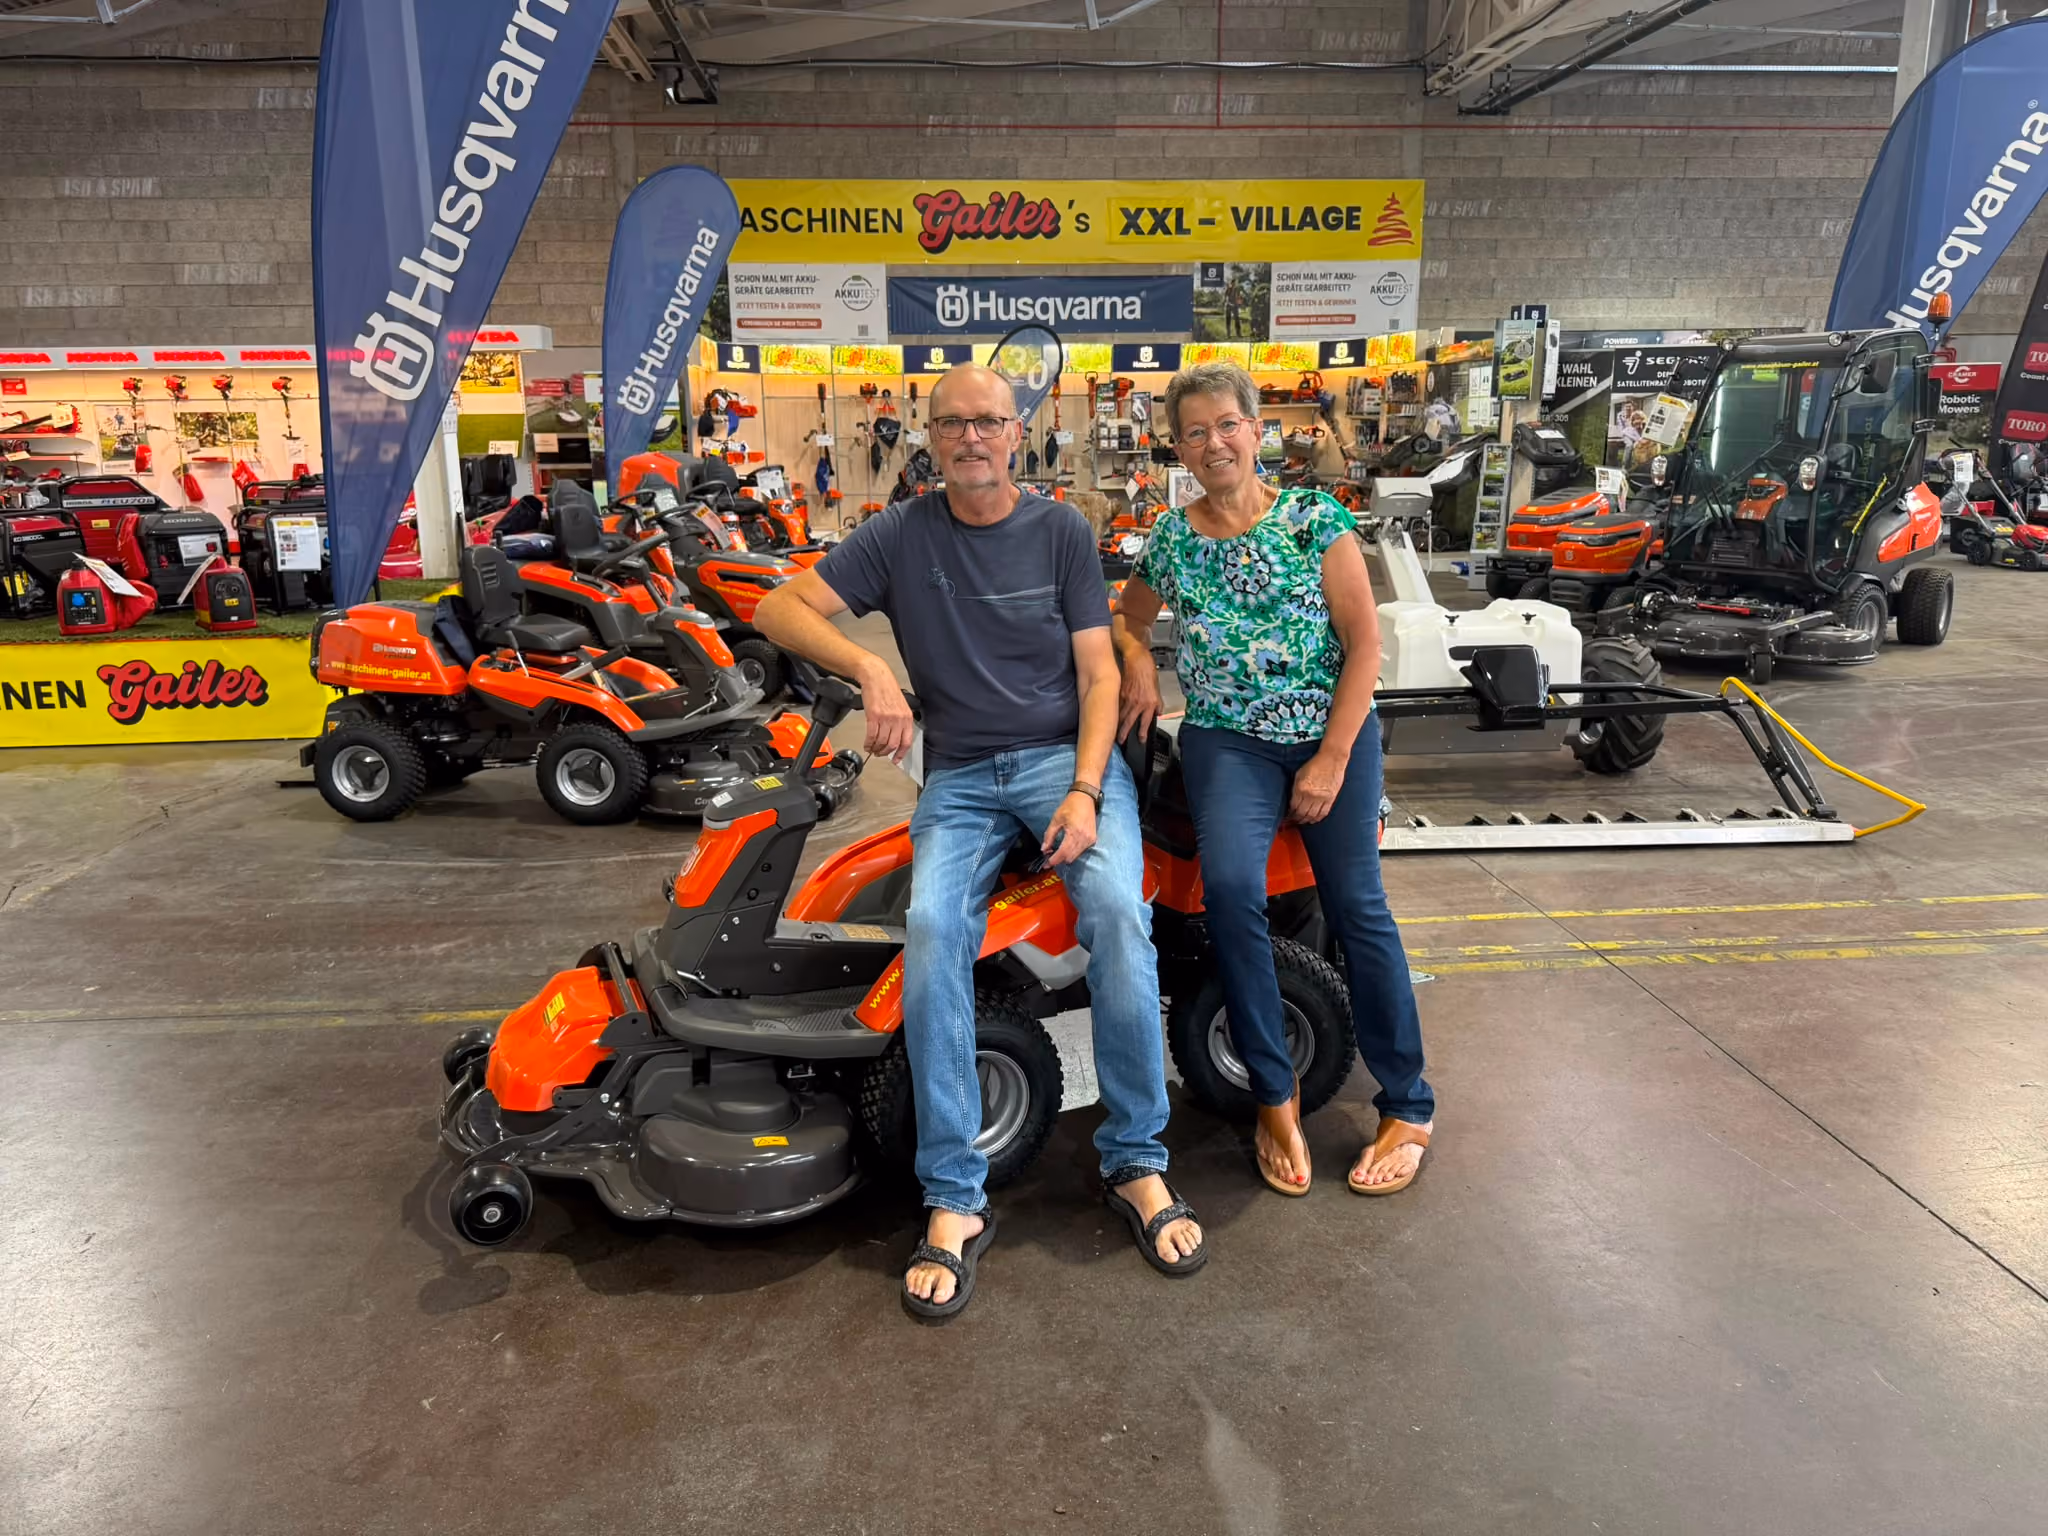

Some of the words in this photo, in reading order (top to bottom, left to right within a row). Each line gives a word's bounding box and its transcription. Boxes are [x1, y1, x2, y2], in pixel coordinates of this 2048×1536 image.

[1119, 207, 1191, 236] XXL
[1231, 206, 1362, 232] VILLAGE
[1424, 260, 1448, 279] ISO
[734, 275, 761, 284] SCHON
[762, 275, 778, 284] MAL
[780, 275, 793, 284] MIT
[795, 275, 821, 284] AKKU-
[1276, 272, 1302, 281] SCHON
[1303, 272, 1318, 281] MAL
[1320, 272, 1333, 281] MIT
[1334, 272, 1358, 281] AKKU-
[735, 285, 763, 295] GERÄTE
[765, 286, 815, 296] GEARBEITET?
[1276, 282, 1303, 293] GERÄTE
[1304, 283, 1352, 293] GEARBEITET?
[633, 227, 720, 384] Husqvarna
[973, 290, 1141, 326] Husqvarna
[1604, 338, 1639, 346] POWERED
[66, 351, 140, 363] HONDA
[153, 351, 226, 362] HONDA
[240, 350, 312, 361] HONDA
[1563, 363, 1594, 375] WAHL
[1940, 394, 1981, 404] Robotic
[1939, 404, 1980, 414] Mowers
[1554, 414, 1569, 423] 305
[2007, 418, 2047, 433] TORO
[0, 680, 87, 710] NEN
[97, 659, 269, 726] Gailer
